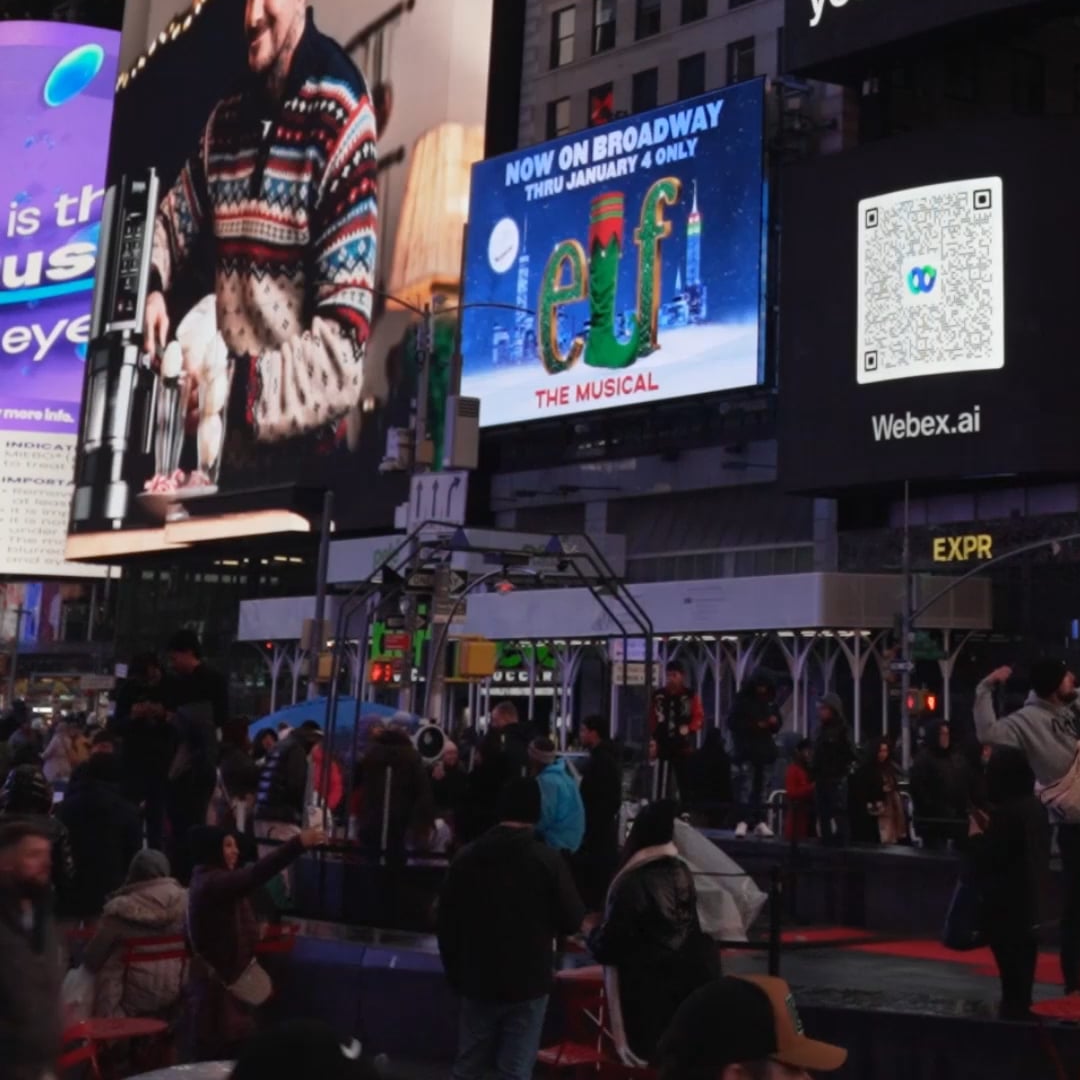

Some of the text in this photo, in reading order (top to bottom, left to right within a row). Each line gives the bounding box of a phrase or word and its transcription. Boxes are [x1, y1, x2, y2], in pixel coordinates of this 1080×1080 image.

[505, 98, 724, 186] NOW ON BROADWAY
[525, 136, 698, 202] THRU JANUARY 4 ONLY
[7, 200, 41, 238] is
[535, 372, 659, 410] THE MUSICAL
[3, 408, 42, 421] more
[872, 405, 981, 442] Webex.ai
[932, 533, 993, 563] EXPR
